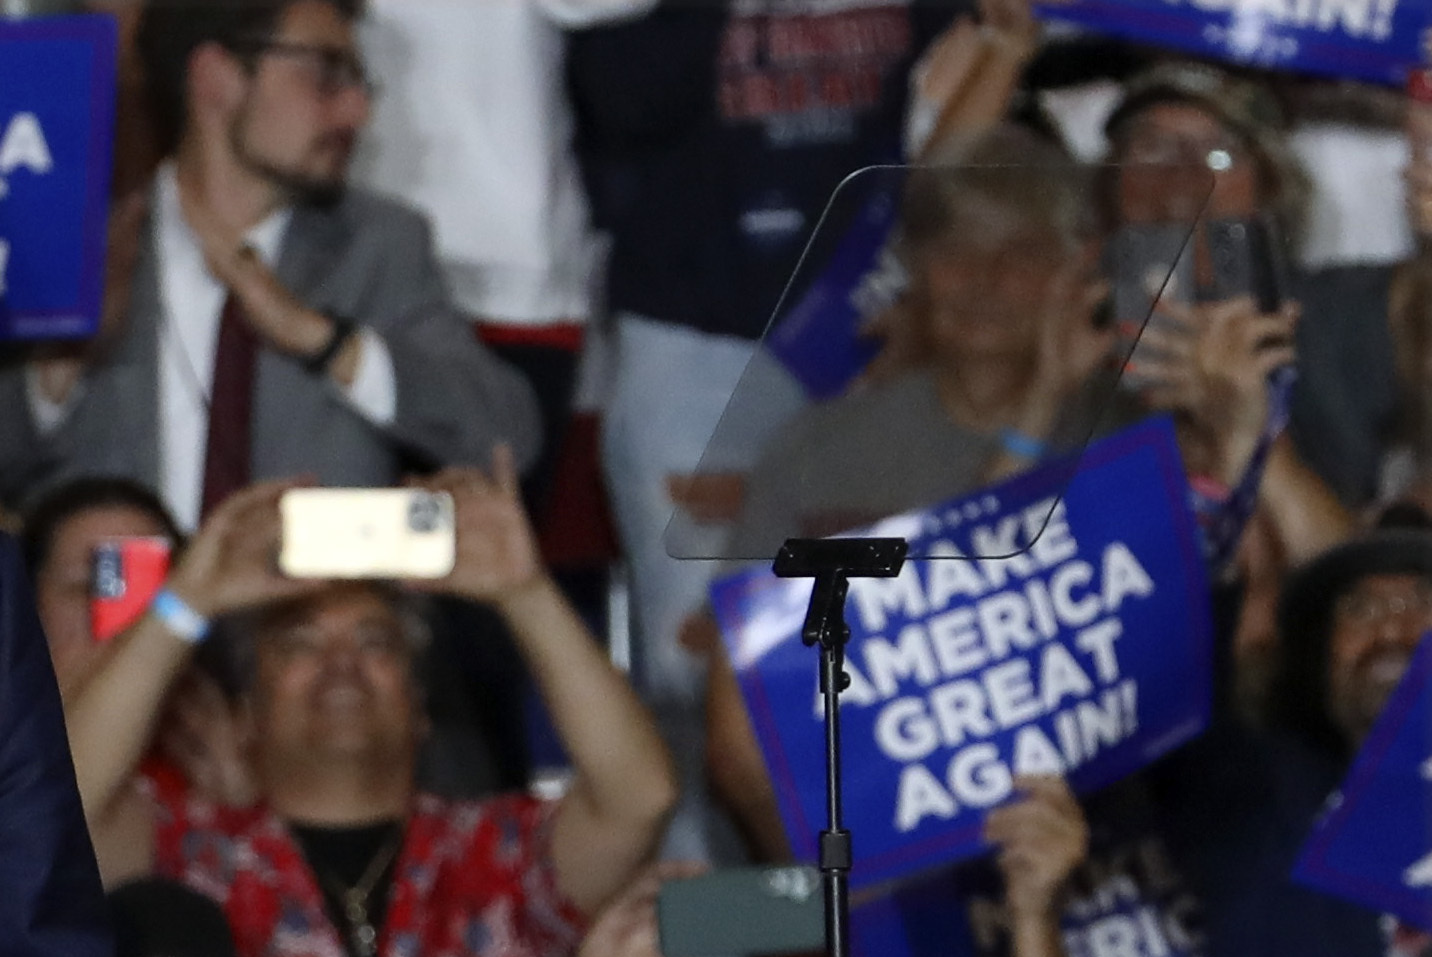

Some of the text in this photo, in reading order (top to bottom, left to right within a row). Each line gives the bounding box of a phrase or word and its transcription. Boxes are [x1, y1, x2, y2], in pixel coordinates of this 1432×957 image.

[848, 495, 1079, 632] MAKE
[874, 617, 1124, 763] GREAT
[893, 678, 1139, 834] AGAIN!
